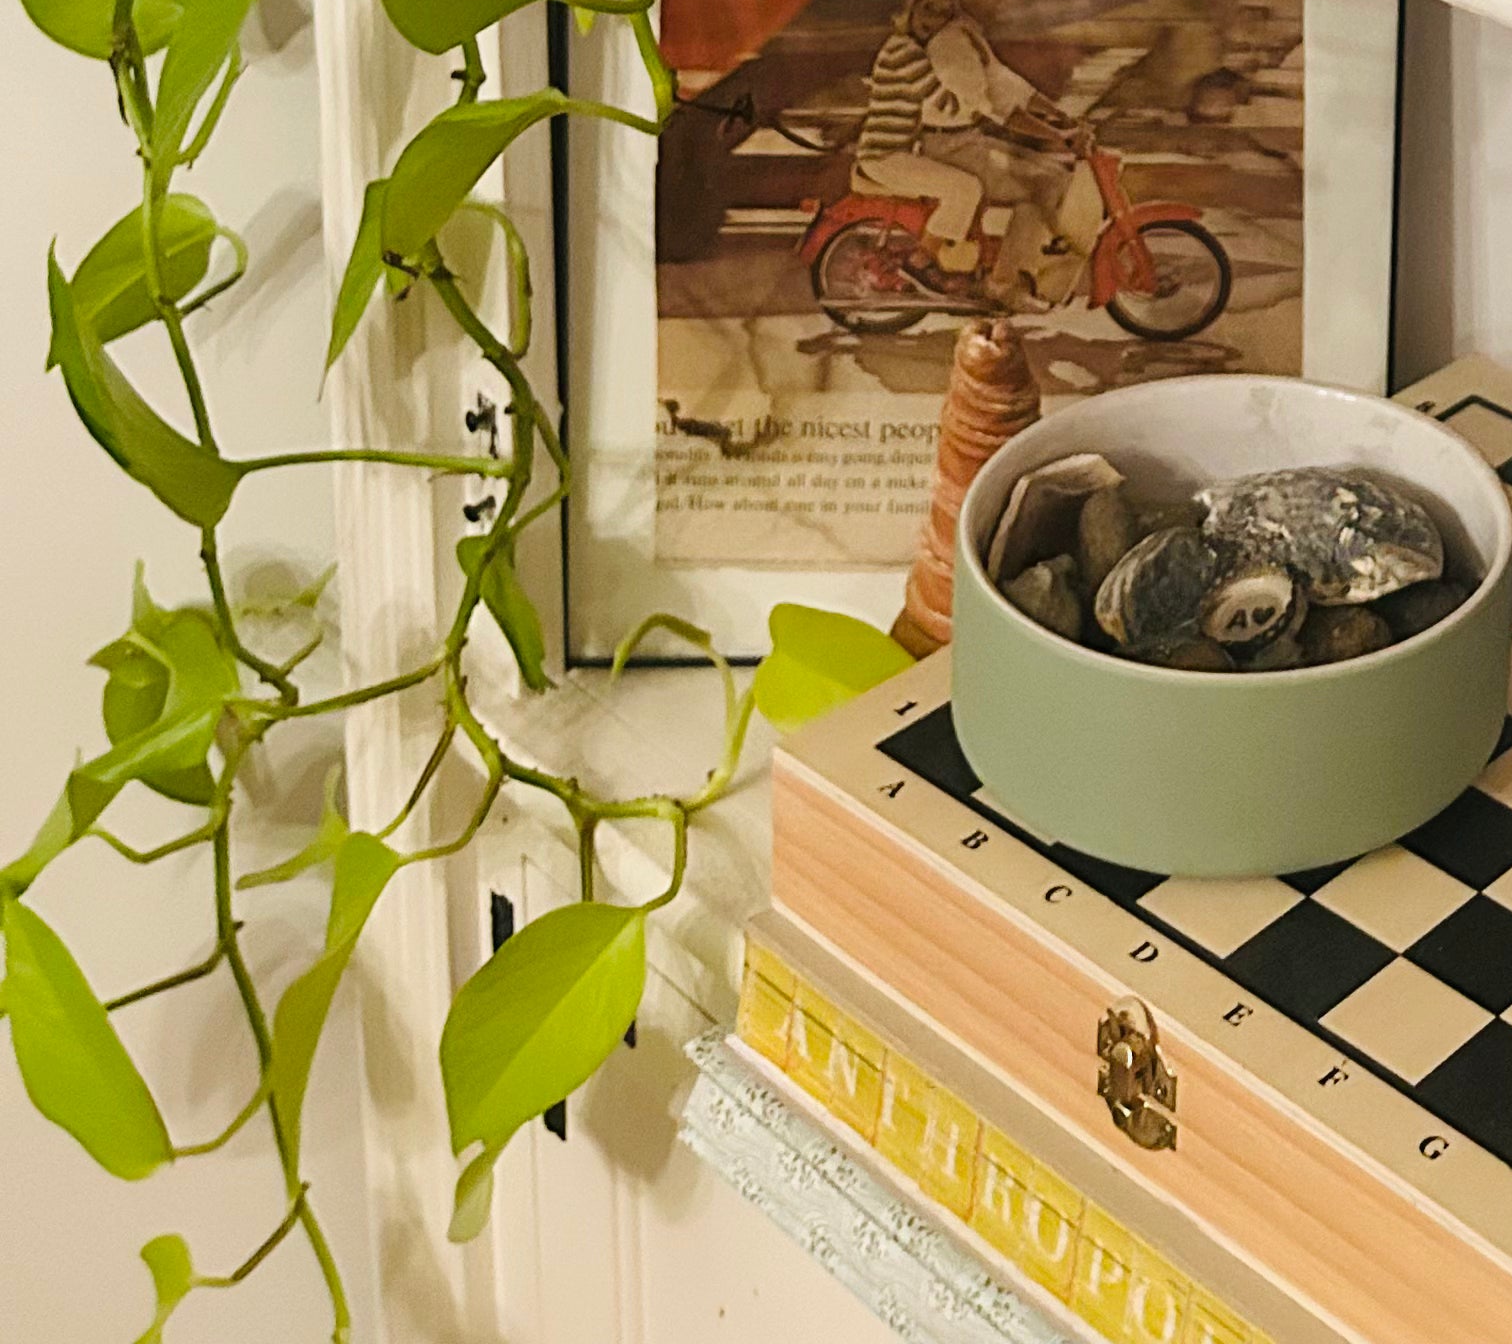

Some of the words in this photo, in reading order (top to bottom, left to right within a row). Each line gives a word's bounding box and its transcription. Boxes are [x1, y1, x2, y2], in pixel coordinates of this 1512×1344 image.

[801, 417, 870, 439] nicest
[1225, 609, 1248, 630] A
[876, 780, 906, 799] A
[961, 829, 990, 850] B
[1045, 885, 1073, 904] C
[1128, 940, 1160, 963] D
[1221, 1001, 1254, 1027] E
[1317, 1066, 1350, 1088] F
[1419, 1135, 1450, 1161] G
